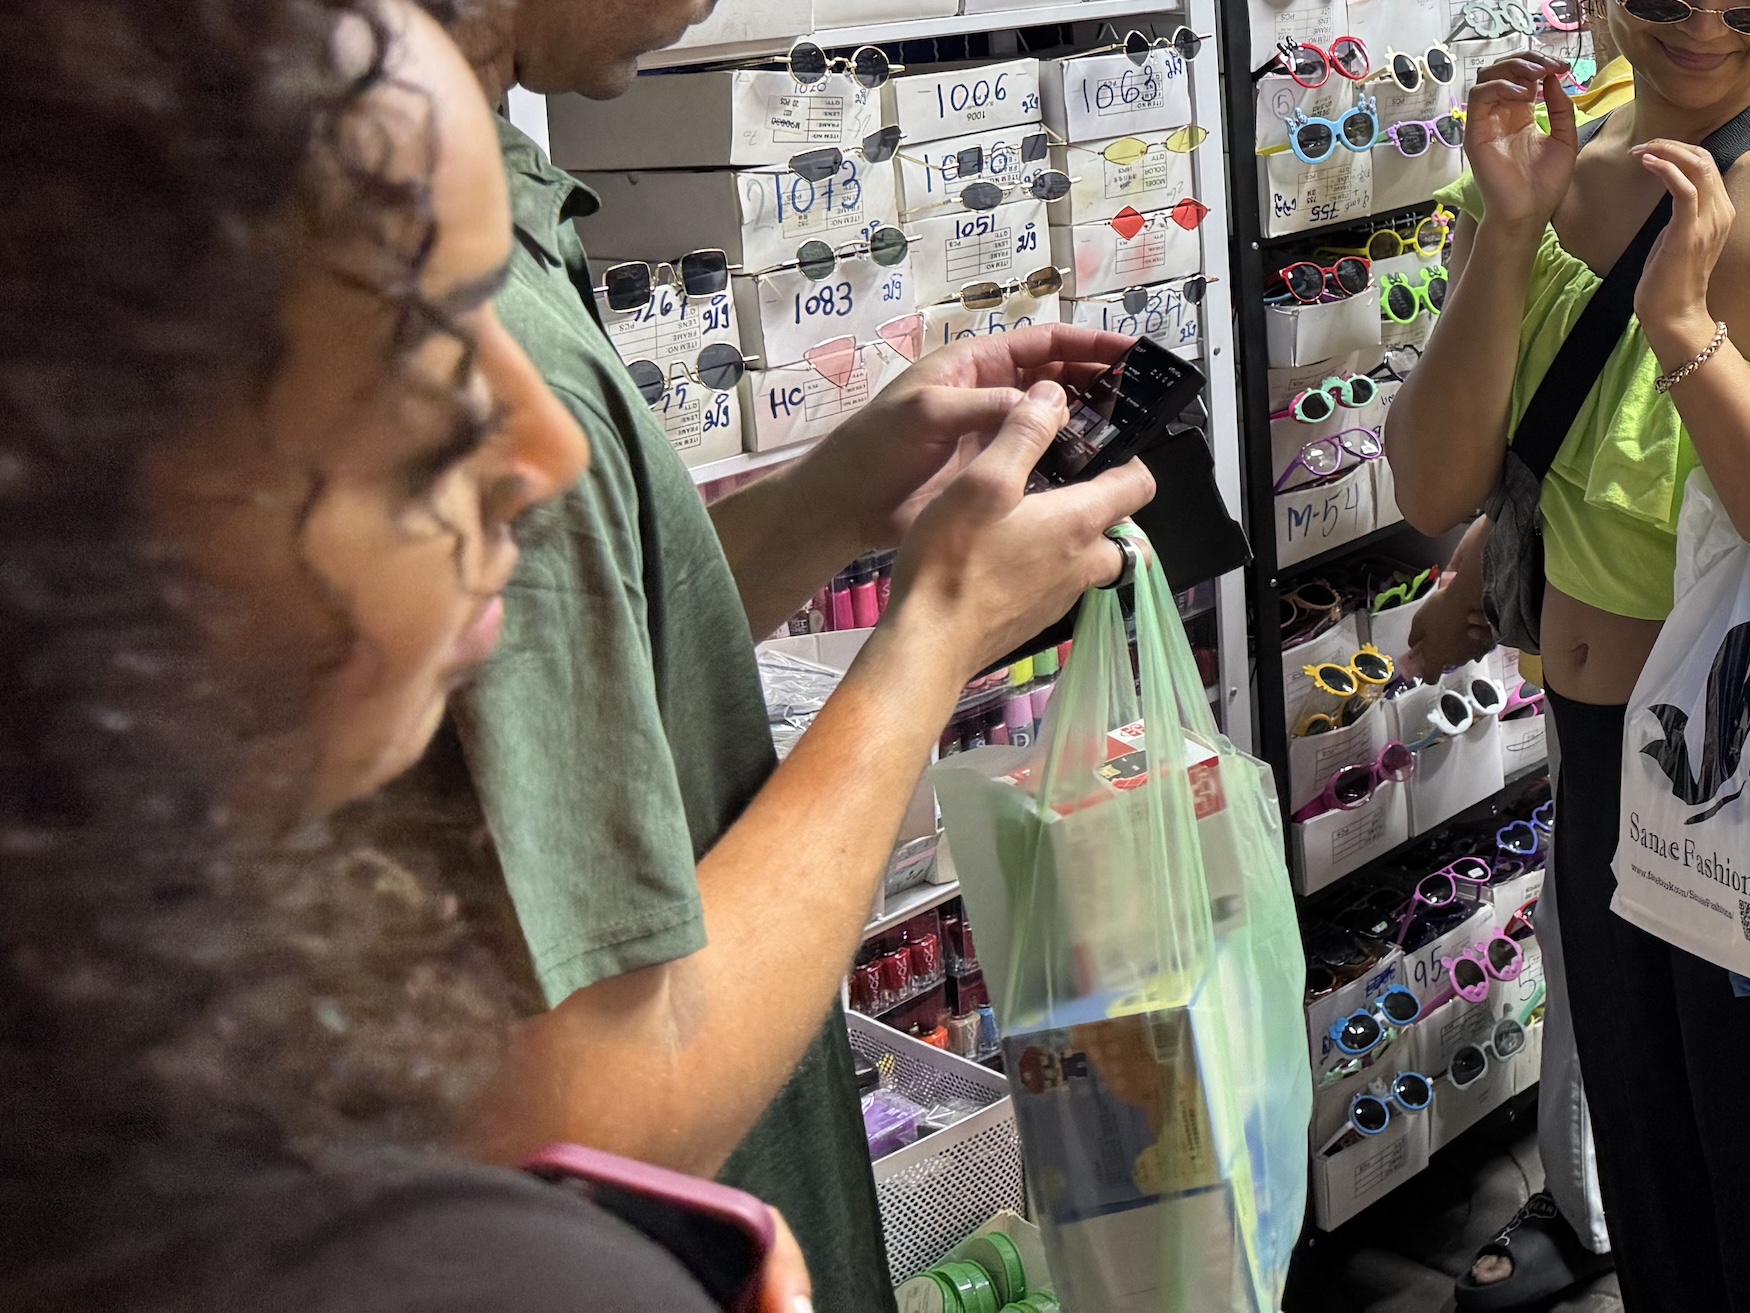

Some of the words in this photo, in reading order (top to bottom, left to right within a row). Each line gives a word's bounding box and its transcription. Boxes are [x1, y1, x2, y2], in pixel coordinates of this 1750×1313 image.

[936, 73, 1009, 119] 1006
[955, 214, 996, 241] 1051
[795, 281, 854, 325] 1083
[770, 387, 805, 420] HC
[1629, 811, 1680, 861] Sanae
